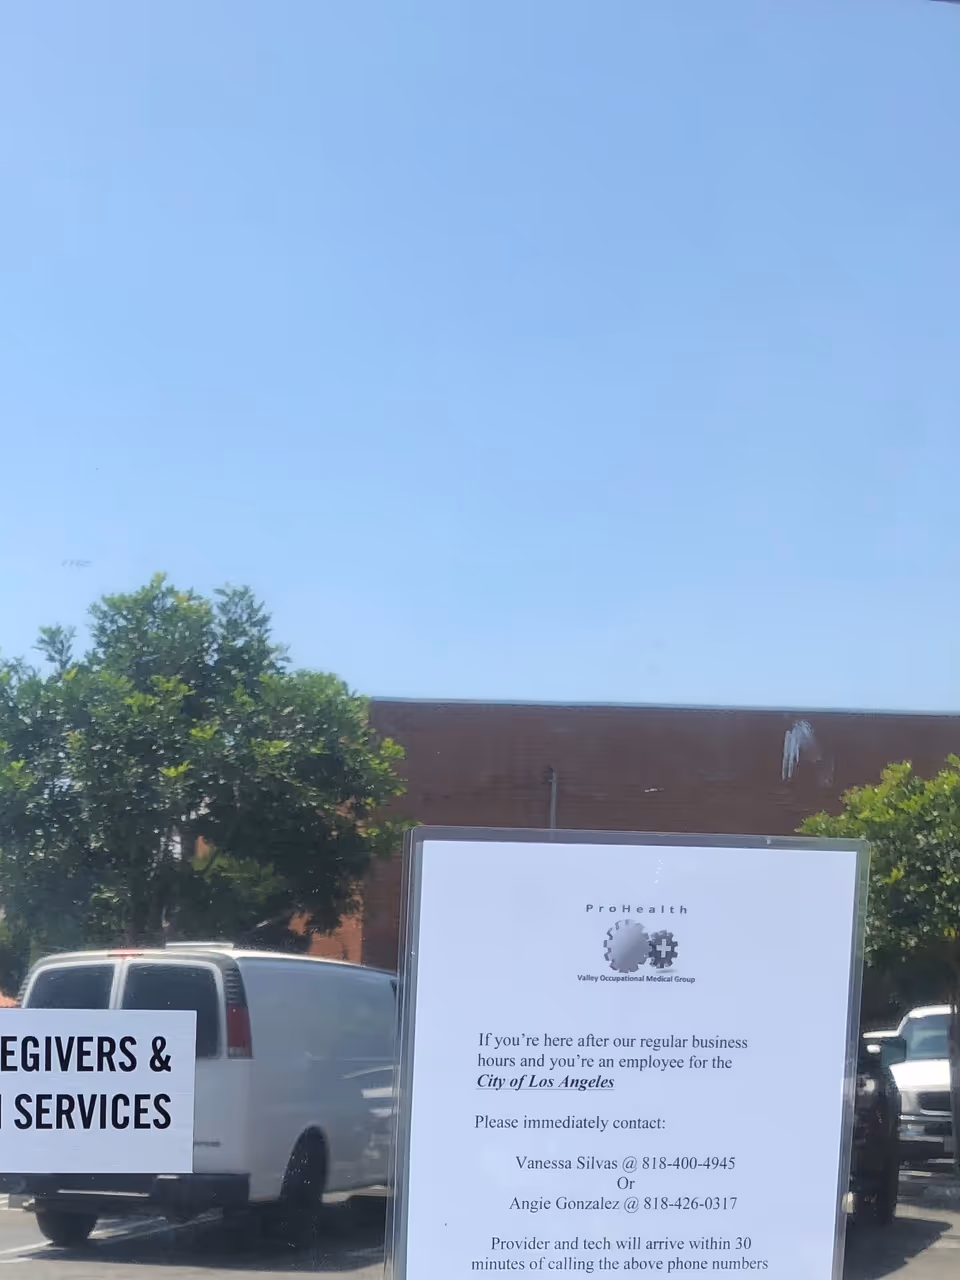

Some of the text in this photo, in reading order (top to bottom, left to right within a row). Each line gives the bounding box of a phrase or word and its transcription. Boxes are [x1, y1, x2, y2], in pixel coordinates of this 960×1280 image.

[585, 904, 688, 914] ProHealth
[577, 974, 696, 984] Valley Occupational Medical Group
[479, 1033, 749, 1051] If you’re here after our regular business
[149, 1036, 172, 1072] &
[478, 1053, 733, 1071] hours and you’re an employee for the
[476, 1074, 615, 1091] City of Los Angeles
[14, 1093, 172, 1130] SERVICES
[475, 1115, 666, 1132] Please immediately contact:
[516, 1156, 736, 1173] Vanessa Silvas @ 818-400-4945
[616, 1176, 636, 1189] Or
[509, 1196, 738, 1213] Angie Gonzalez @ 818-426-0317
[490, 1237, 752, 1250] Provider and tech will arrive within 30
[471, 1257, 769, 1273] minutes of calling the above phone numbers
